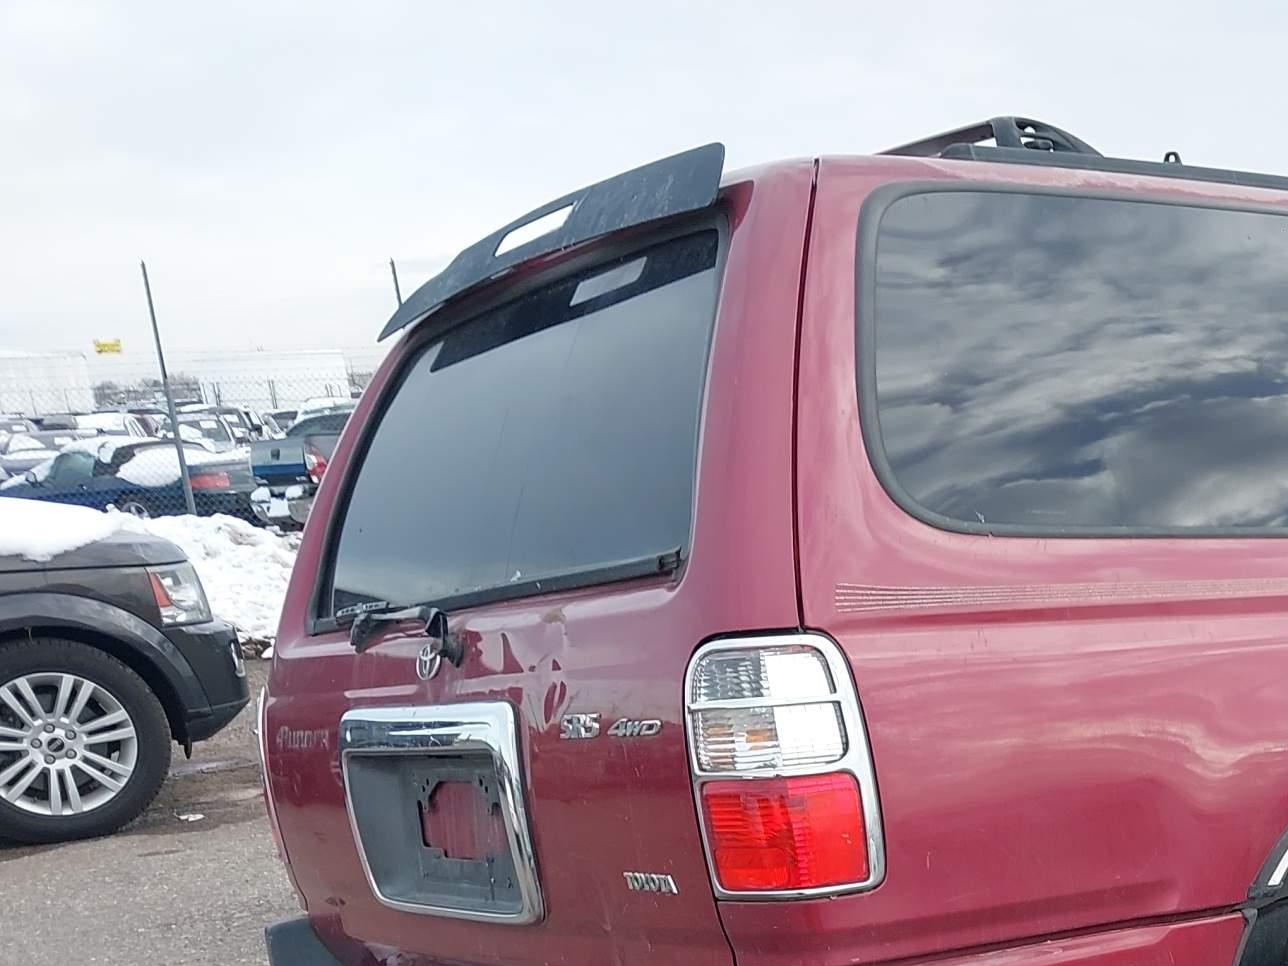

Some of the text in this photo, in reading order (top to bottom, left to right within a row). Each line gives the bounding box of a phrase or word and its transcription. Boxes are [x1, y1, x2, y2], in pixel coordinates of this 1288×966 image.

[560, 713, 662, 739] SR5 4WD
[623, 871, 678, 895] TOYOTA
